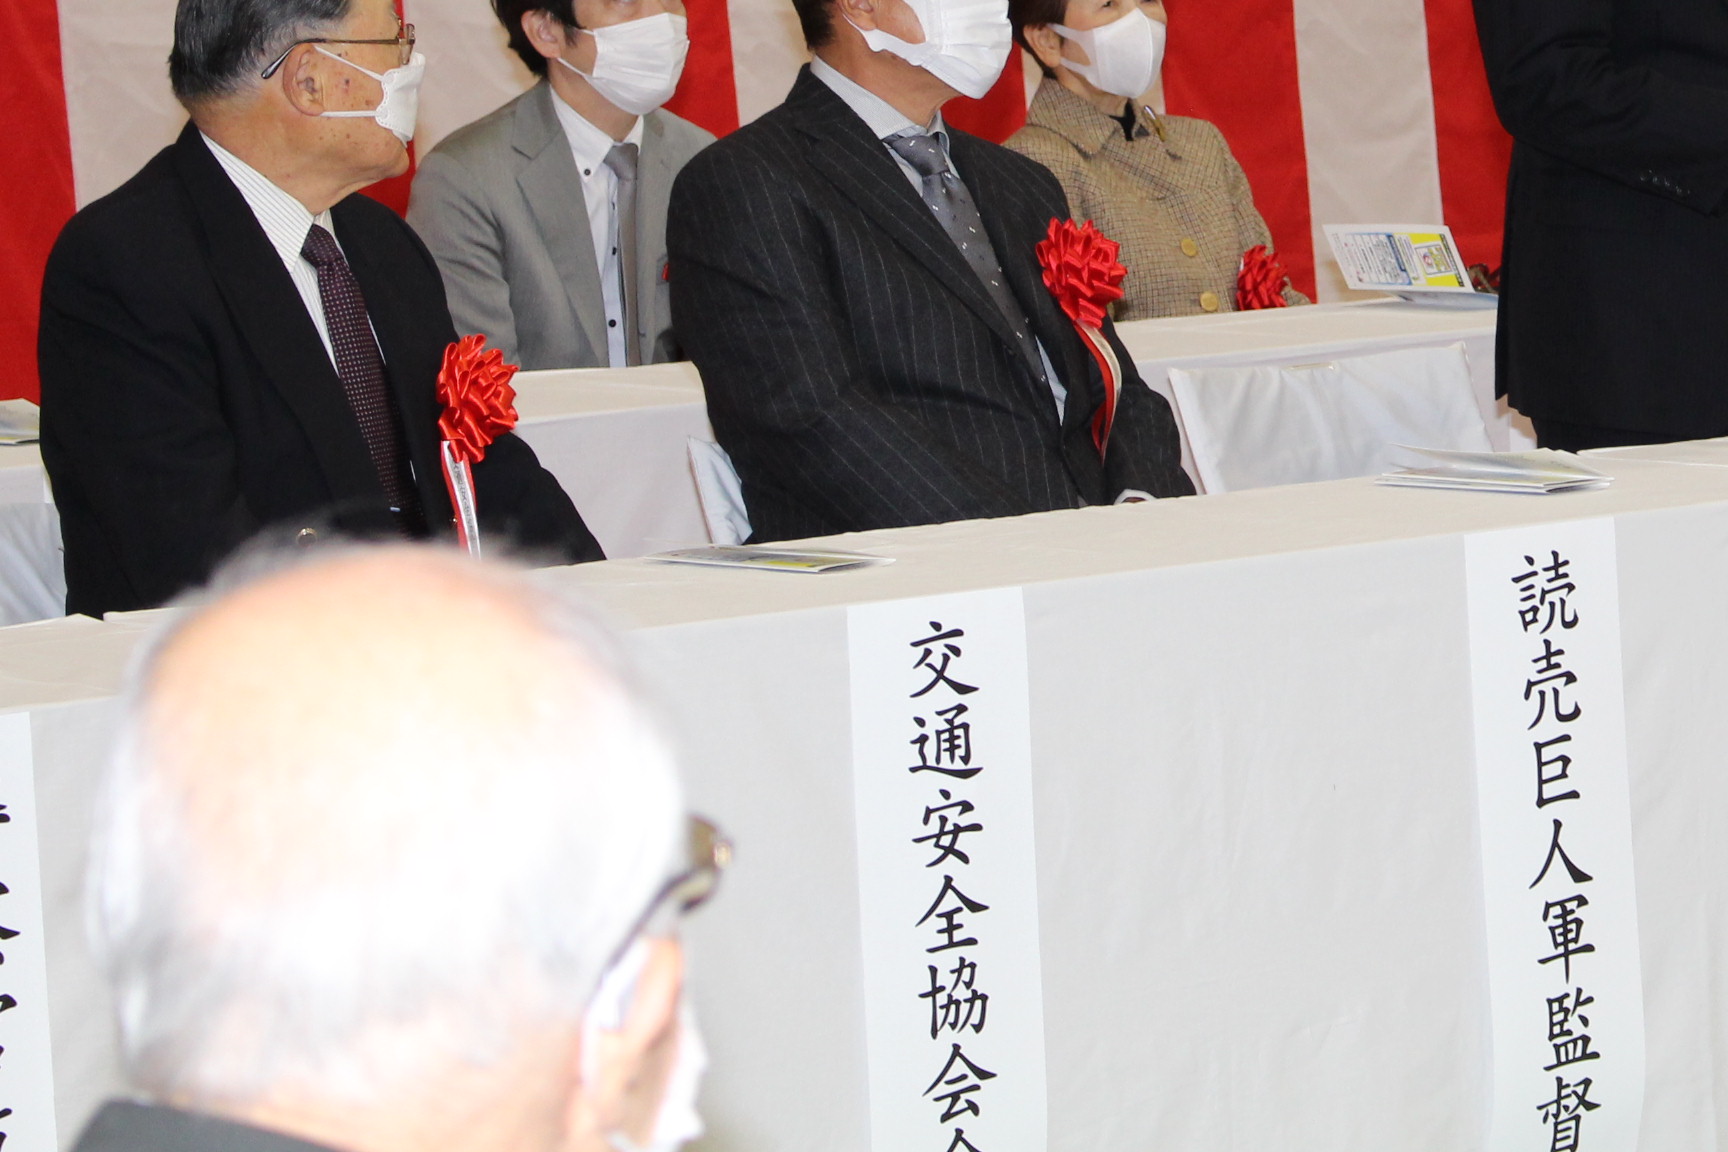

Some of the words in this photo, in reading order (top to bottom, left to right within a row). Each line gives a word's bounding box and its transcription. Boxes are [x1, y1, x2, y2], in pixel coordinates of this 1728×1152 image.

[908, 620, 998, 1152] 交通安全協会
[1511, 550, 1602, 1152] 読売巨人軍監督
